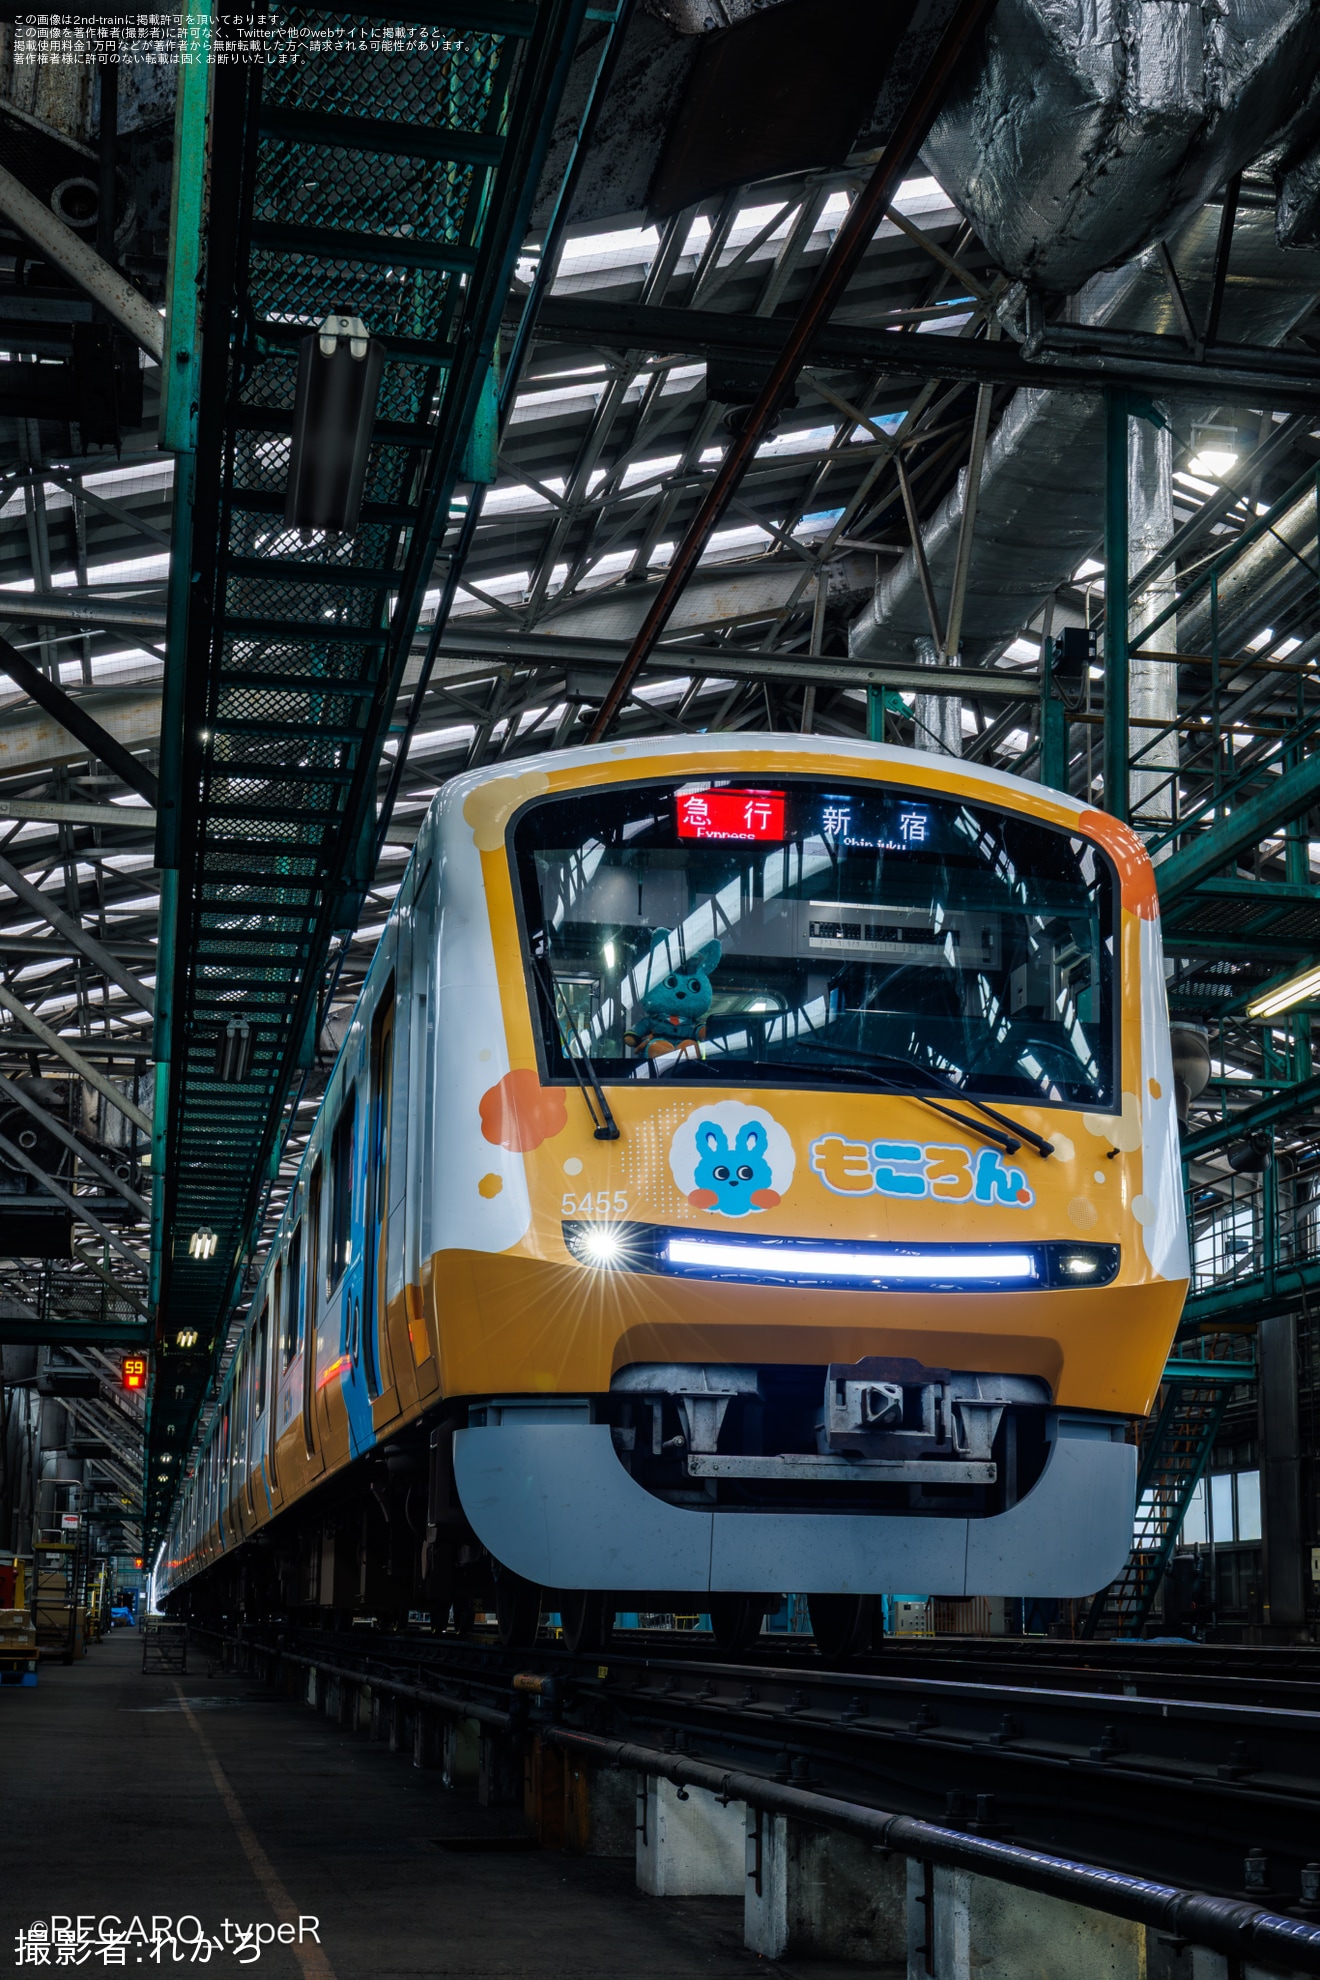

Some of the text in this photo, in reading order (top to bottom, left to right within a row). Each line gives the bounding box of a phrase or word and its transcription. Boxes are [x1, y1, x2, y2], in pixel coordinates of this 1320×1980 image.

[683, 796, 773, 830] 急行
[822, 805, 928, 841] 新宿
[810, 1133, 1035, 1209] もころん
[561, 1190, 628, 1216] 5455
[125, 1360, 143, 1374] 59
